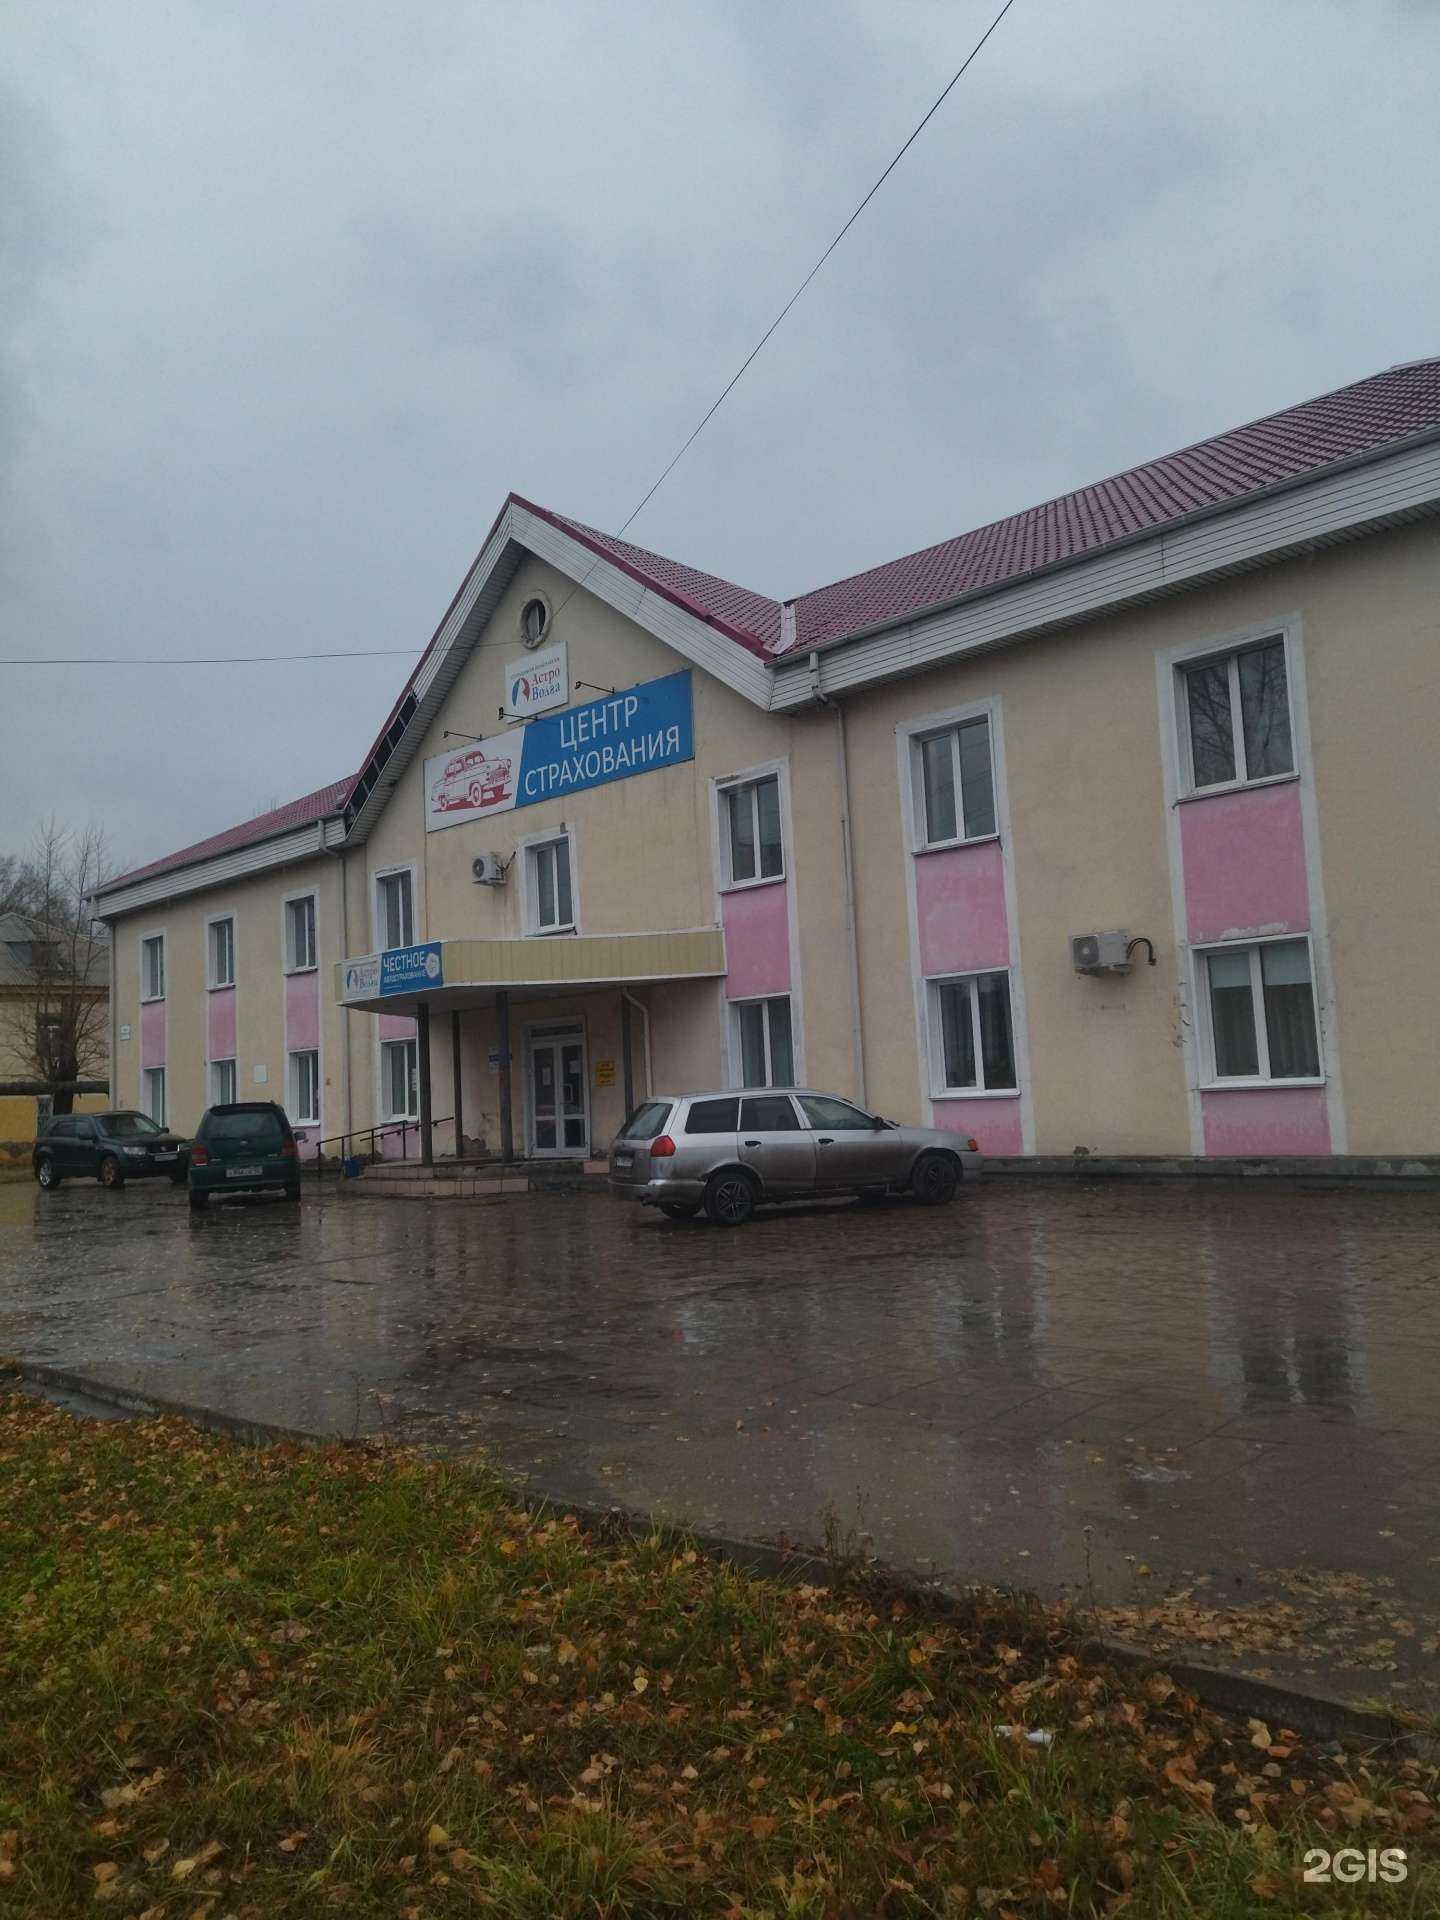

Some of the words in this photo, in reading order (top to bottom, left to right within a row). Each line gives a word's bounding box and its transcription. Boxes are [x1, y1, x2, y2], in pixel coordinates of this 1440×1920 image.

[531, 667, 560, 686] Астро
[532, 682, 560, 700] Волга
[560, 695, 639, 751] ЦЕНТР
[525, 725, 679, 796] СТРАХОВАНИЯ
[383, 951, 425, 972] ЧЕСТНОЕ
